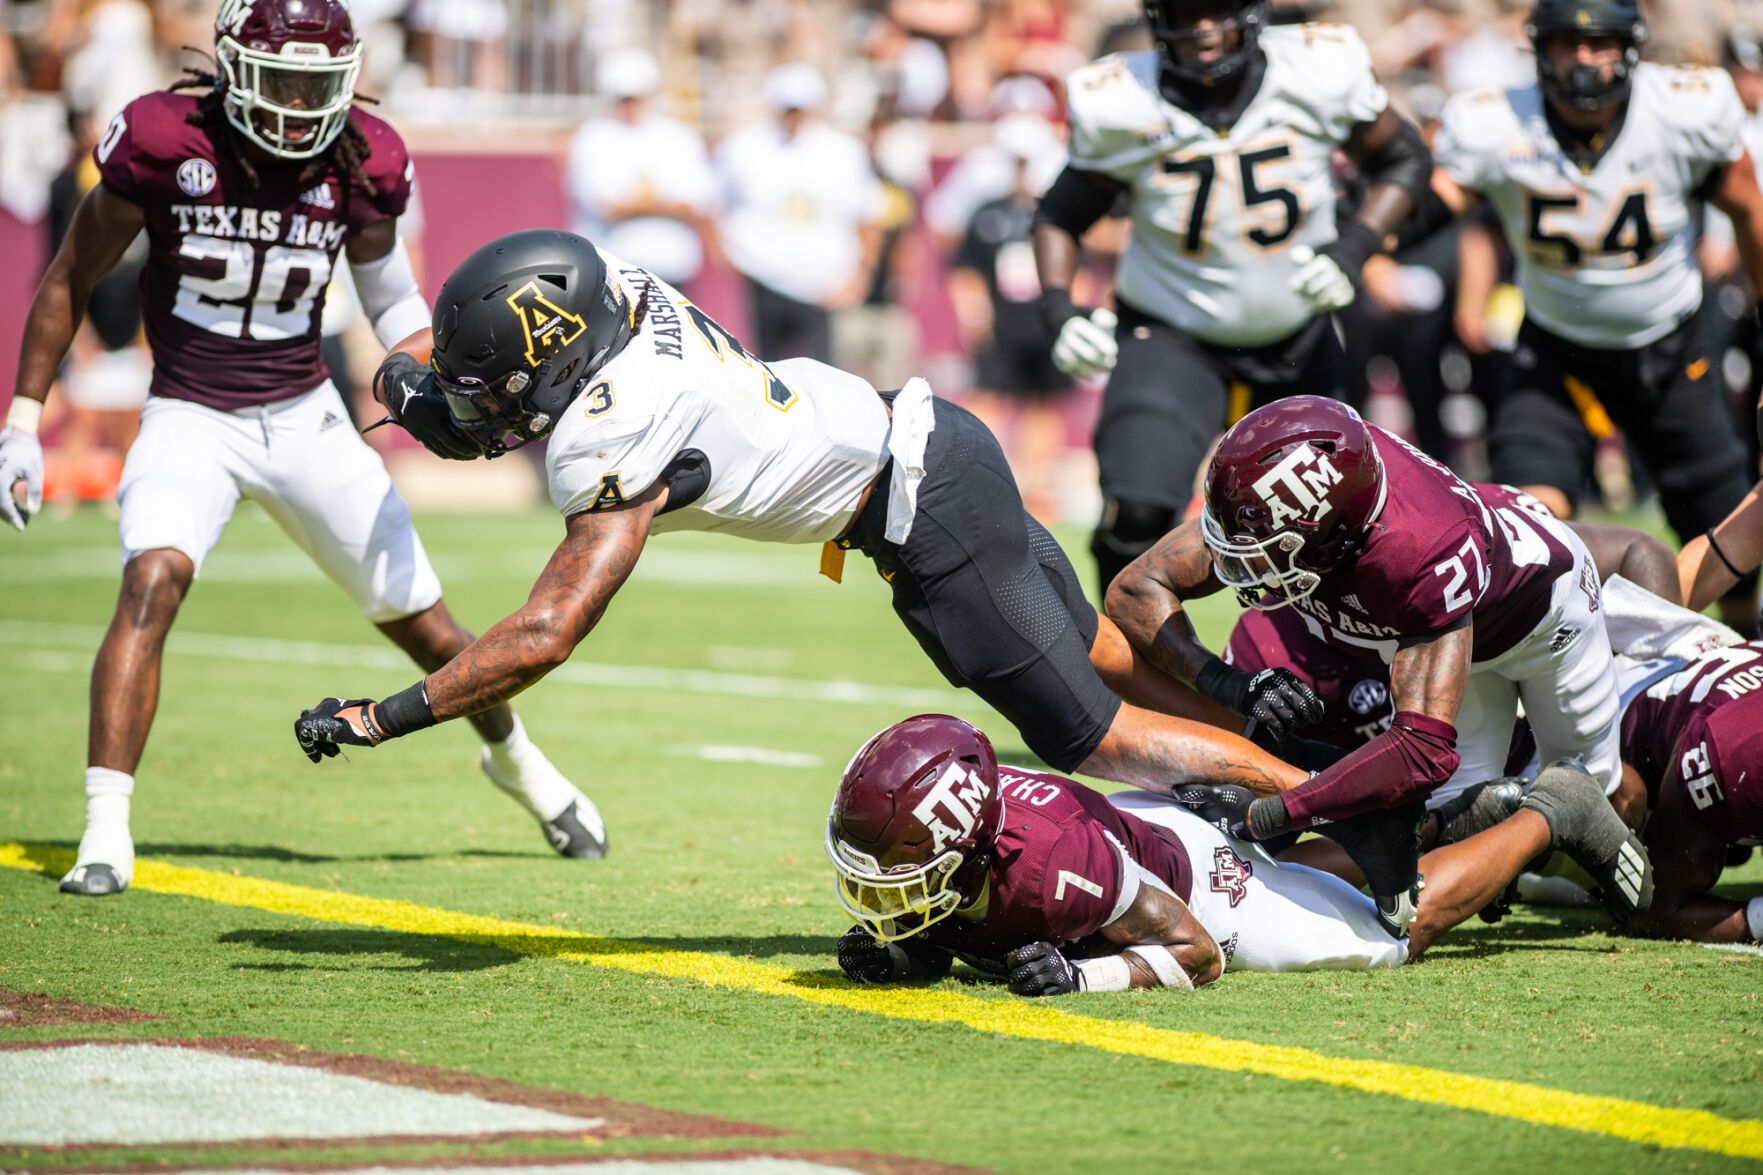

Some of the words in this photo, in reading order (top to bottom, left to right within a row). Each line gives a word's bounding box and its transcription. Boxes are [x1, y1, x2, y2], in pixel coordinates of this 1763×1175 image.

[179, 162, 213, 193] SEC
[1154, 130, 1311, 262] 75
[171, 204, 282, 241] TEXAS
[285, 213, 348, 250] A&M
[1526, 180, 1662, 270] 54
[171, 233, 331, 341] 20
[619, 268, 683, 360] MARSHALL
[506, 281, 588, 368] A
[583, 379, 616, 419] 3
[585, 471, 626, 512] A
[1434, 535, 1485, 613] 27
[1681, 741, 1724, 810] 92
[1054, 869, 1104, 901] 7
